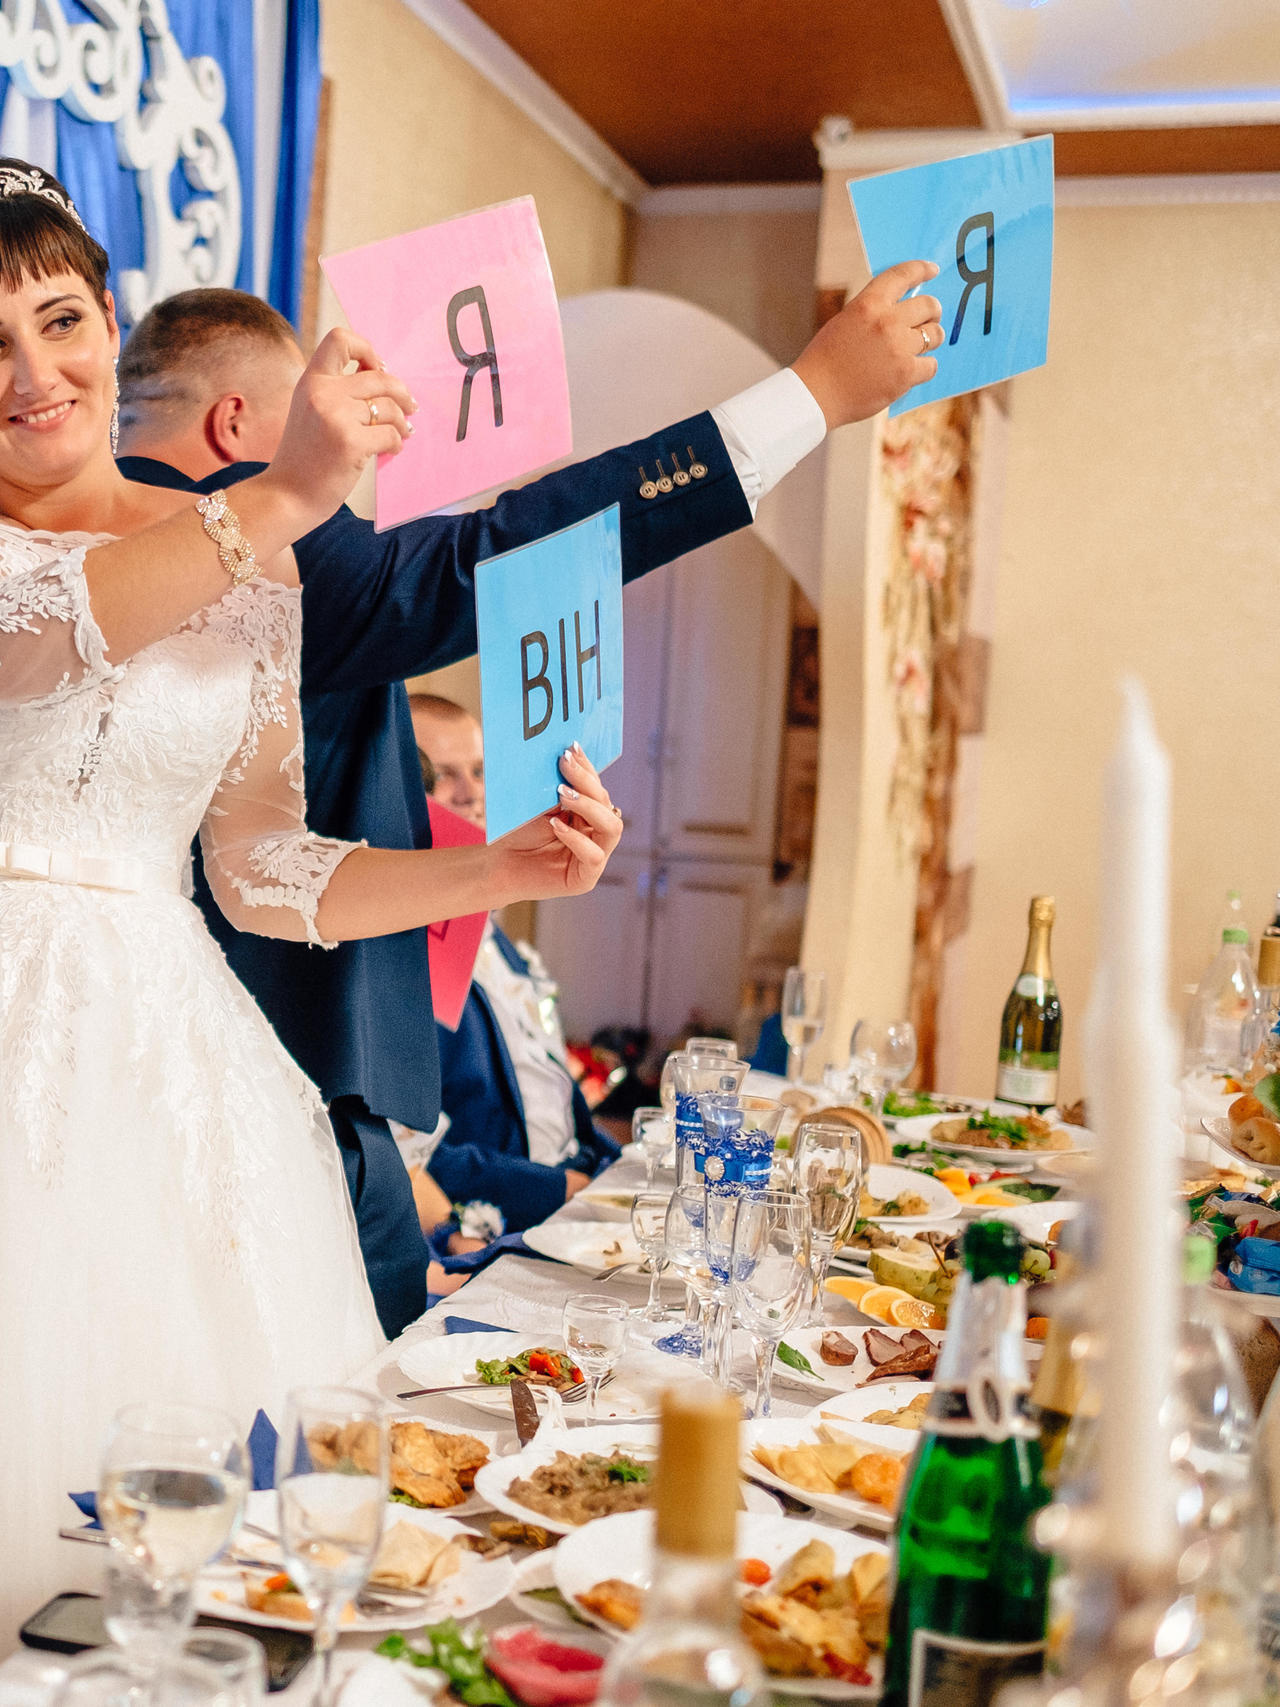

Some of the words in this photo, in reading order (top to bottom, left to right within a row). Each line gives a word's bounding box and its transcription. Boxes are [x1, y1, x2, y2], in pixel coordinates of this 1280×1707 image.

[949, 211, 995, 346] Я
[447, 285, 504, 442] Я
[520, 600, 602, 742] ВІН
